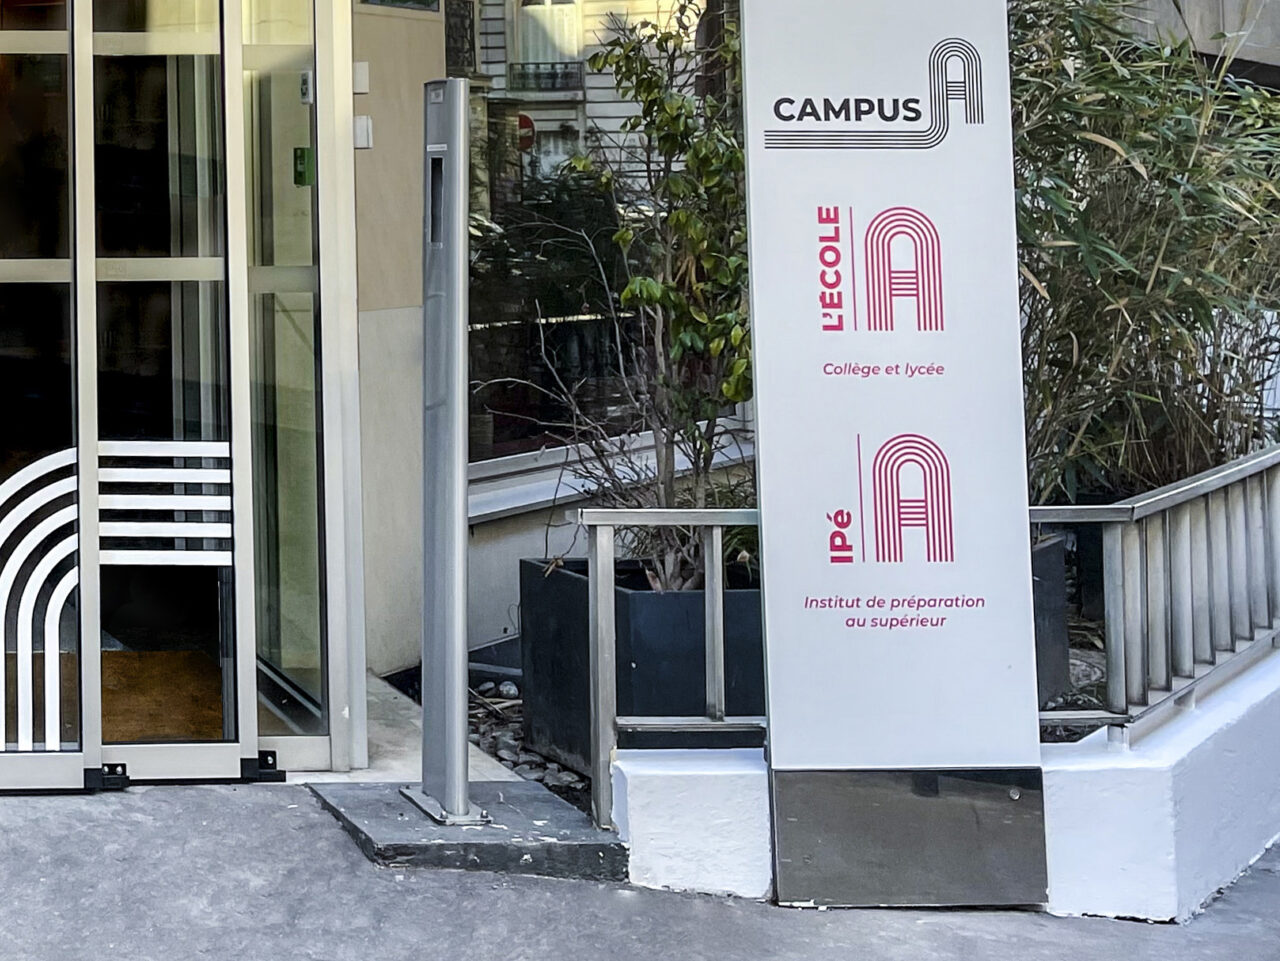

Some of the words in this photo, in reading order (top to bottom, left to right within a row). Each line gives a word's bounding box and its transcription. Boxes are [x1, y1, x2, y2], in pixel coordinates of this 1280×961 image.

[773, 97, 923, 122] CAMPUS
[817, 205, 845, 332] L'ÉCOLE
[822, 362, 881, 379] Collège
[884, 363, 901, 376] et
[904, 362, 945, 378] lycée
[826, 508, 854, 564] IPé
[804, 595, 862, 609] Institut
[865, 595, 886, 609] de
[889, 594, 986, 612] préparation
[845, 617, 867, 628] au
[870, 613, 947, 630] supérieur
